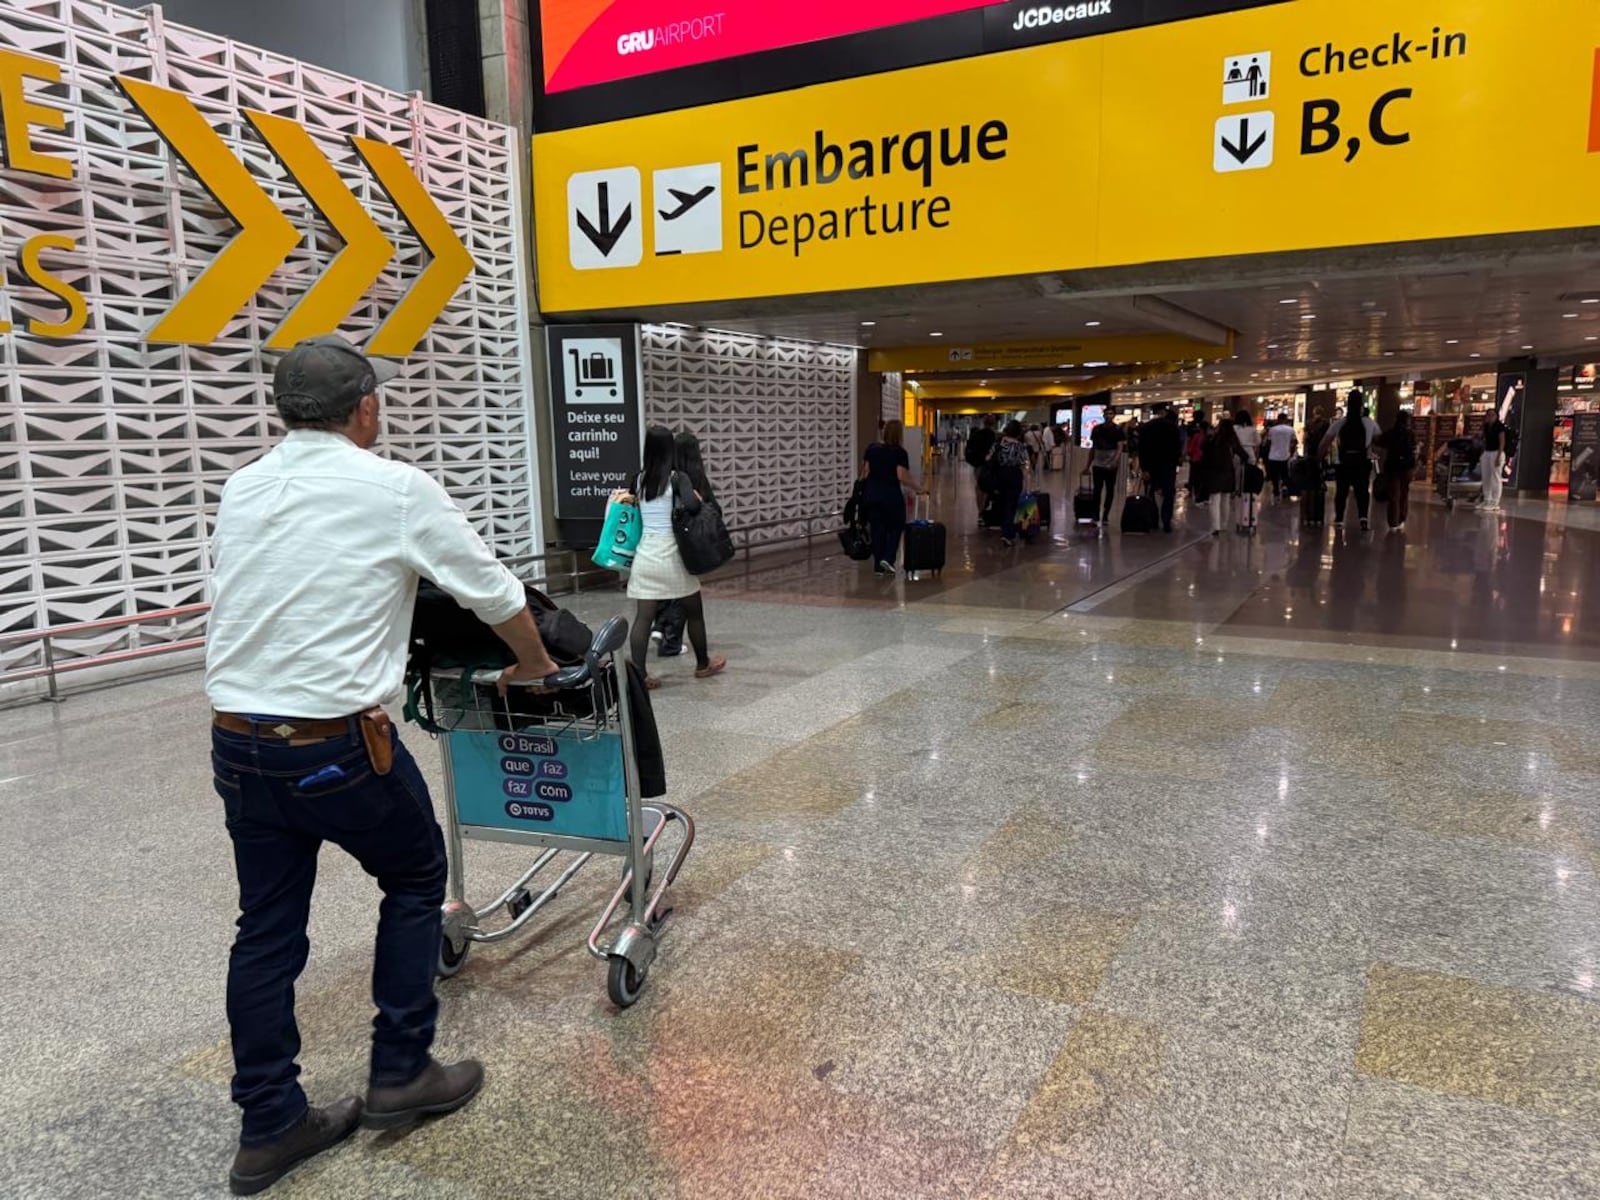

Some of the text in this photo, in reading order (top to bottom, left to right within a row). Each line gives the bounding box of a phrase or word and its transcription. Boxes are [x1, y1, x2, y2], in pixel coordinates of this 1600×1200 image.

[1013, 0, 1111, 30] JCDecaux
[1299, 27, 1467, 77] Check-in
[1299, 87, 1413, 163] B,C
[736, 118, 1009, 195] Embarque
[739, 194, 951, 257] Departure
[567, 411, 625, 424] Deixe seu
[568, 428, 618, 442] carrinho
[569, 446, 600, 462] aqui!
[570, 469, 627, 484] Leave your
[570, 485, 592, 496] cart
[503, 737, 554, 754] O Brasil
[505, 760, 563, 775] que faz
[507, 780, 568, 798] faz com
[522, 806, 549, 816] TOTVS
